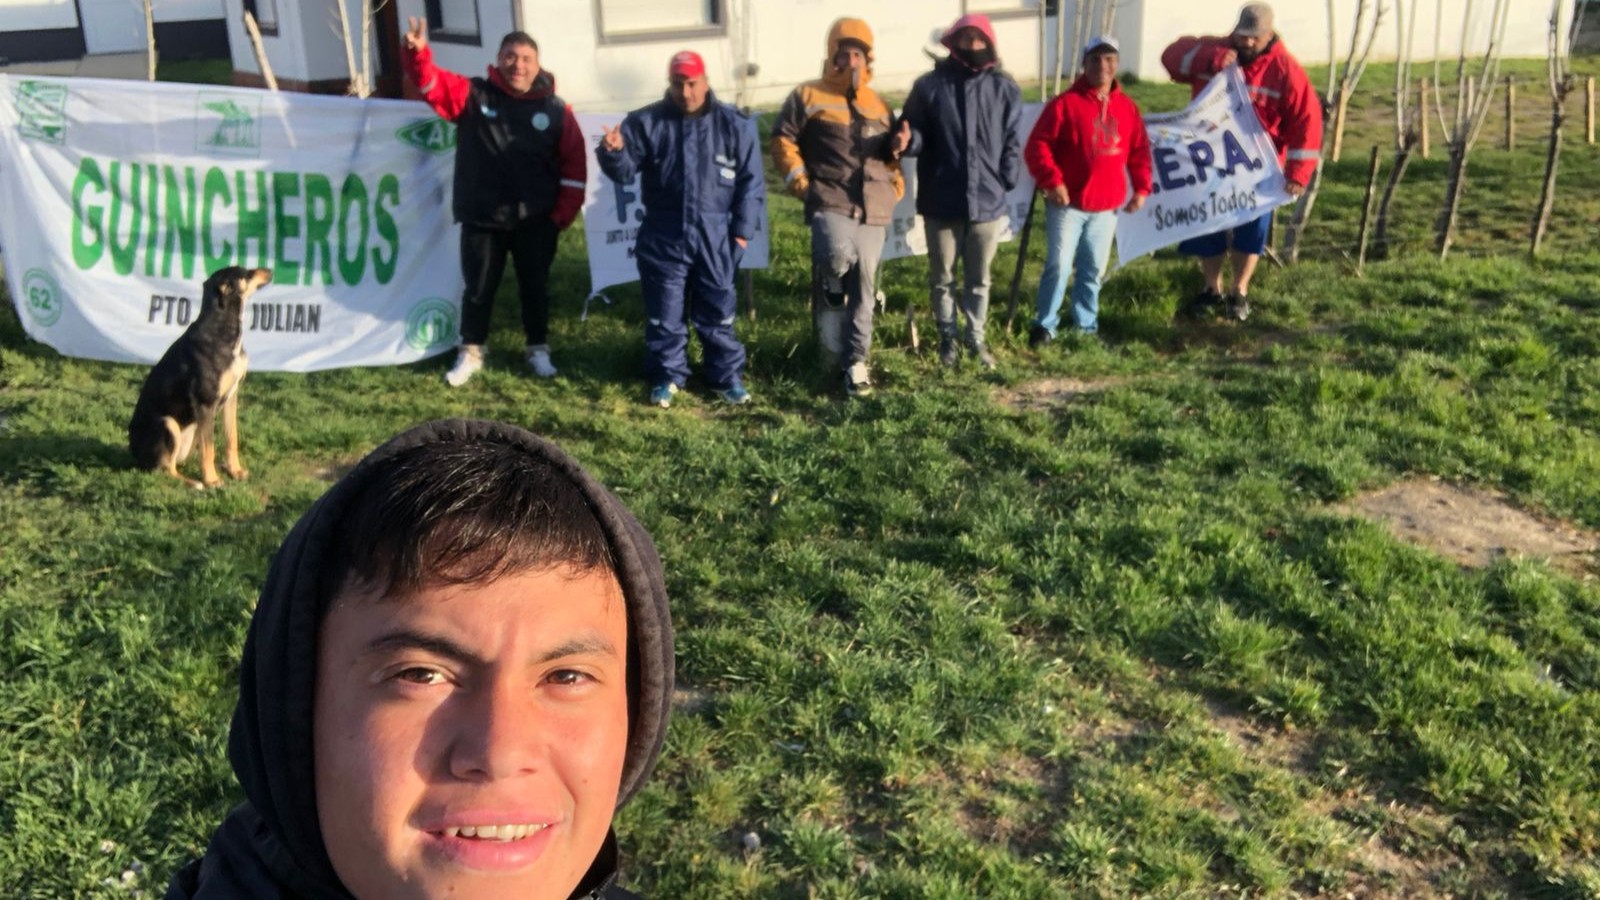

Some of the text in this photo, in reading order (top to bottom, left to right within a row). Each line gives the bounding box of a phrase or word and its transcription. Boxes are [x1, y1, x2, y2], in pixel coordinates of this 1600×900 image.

[1209, 186, 1257, 217] Todos
[71, 157, 400, 287] GUINCHEROS
[148, 294, 322, 333] PTO JULIAN
